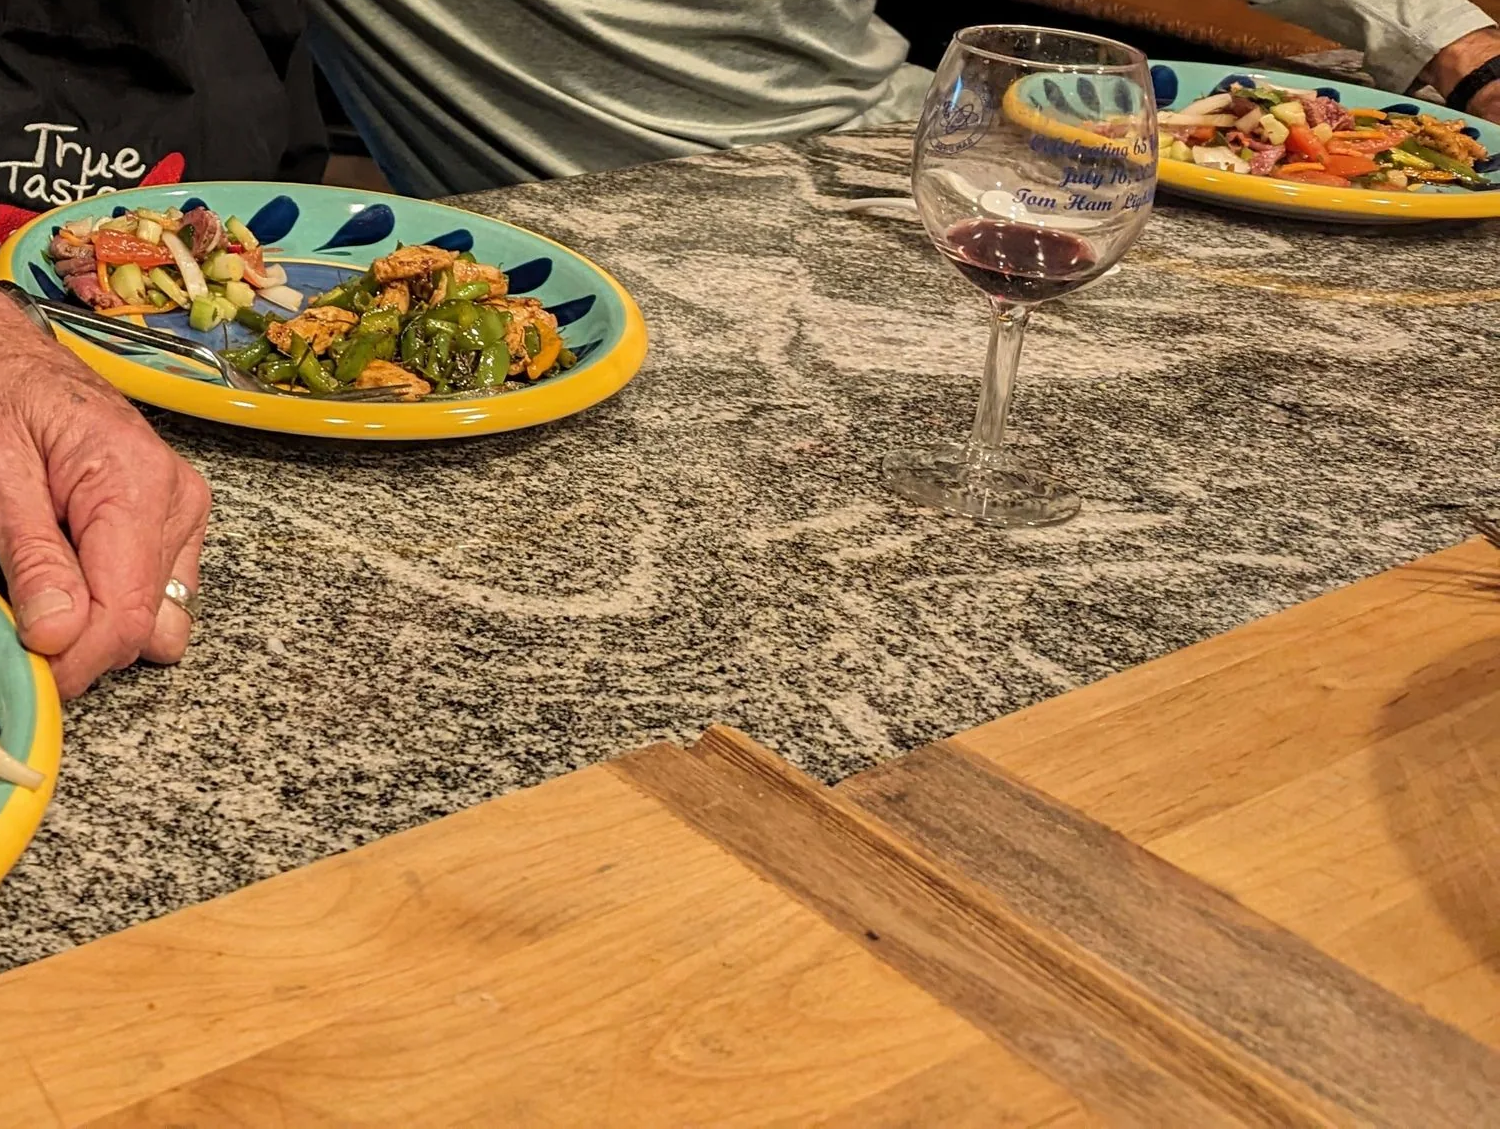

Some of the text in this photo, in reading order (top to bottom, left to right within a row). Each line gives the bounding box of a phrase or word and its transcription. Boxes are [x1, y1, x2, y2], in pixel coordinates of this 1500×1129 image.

[24, 122, 146, 180] True
[1133, 137, 1148, 155] 65
[1058, 165, 1105, 190] July
[1012, 188, 1057, 209] Tom
